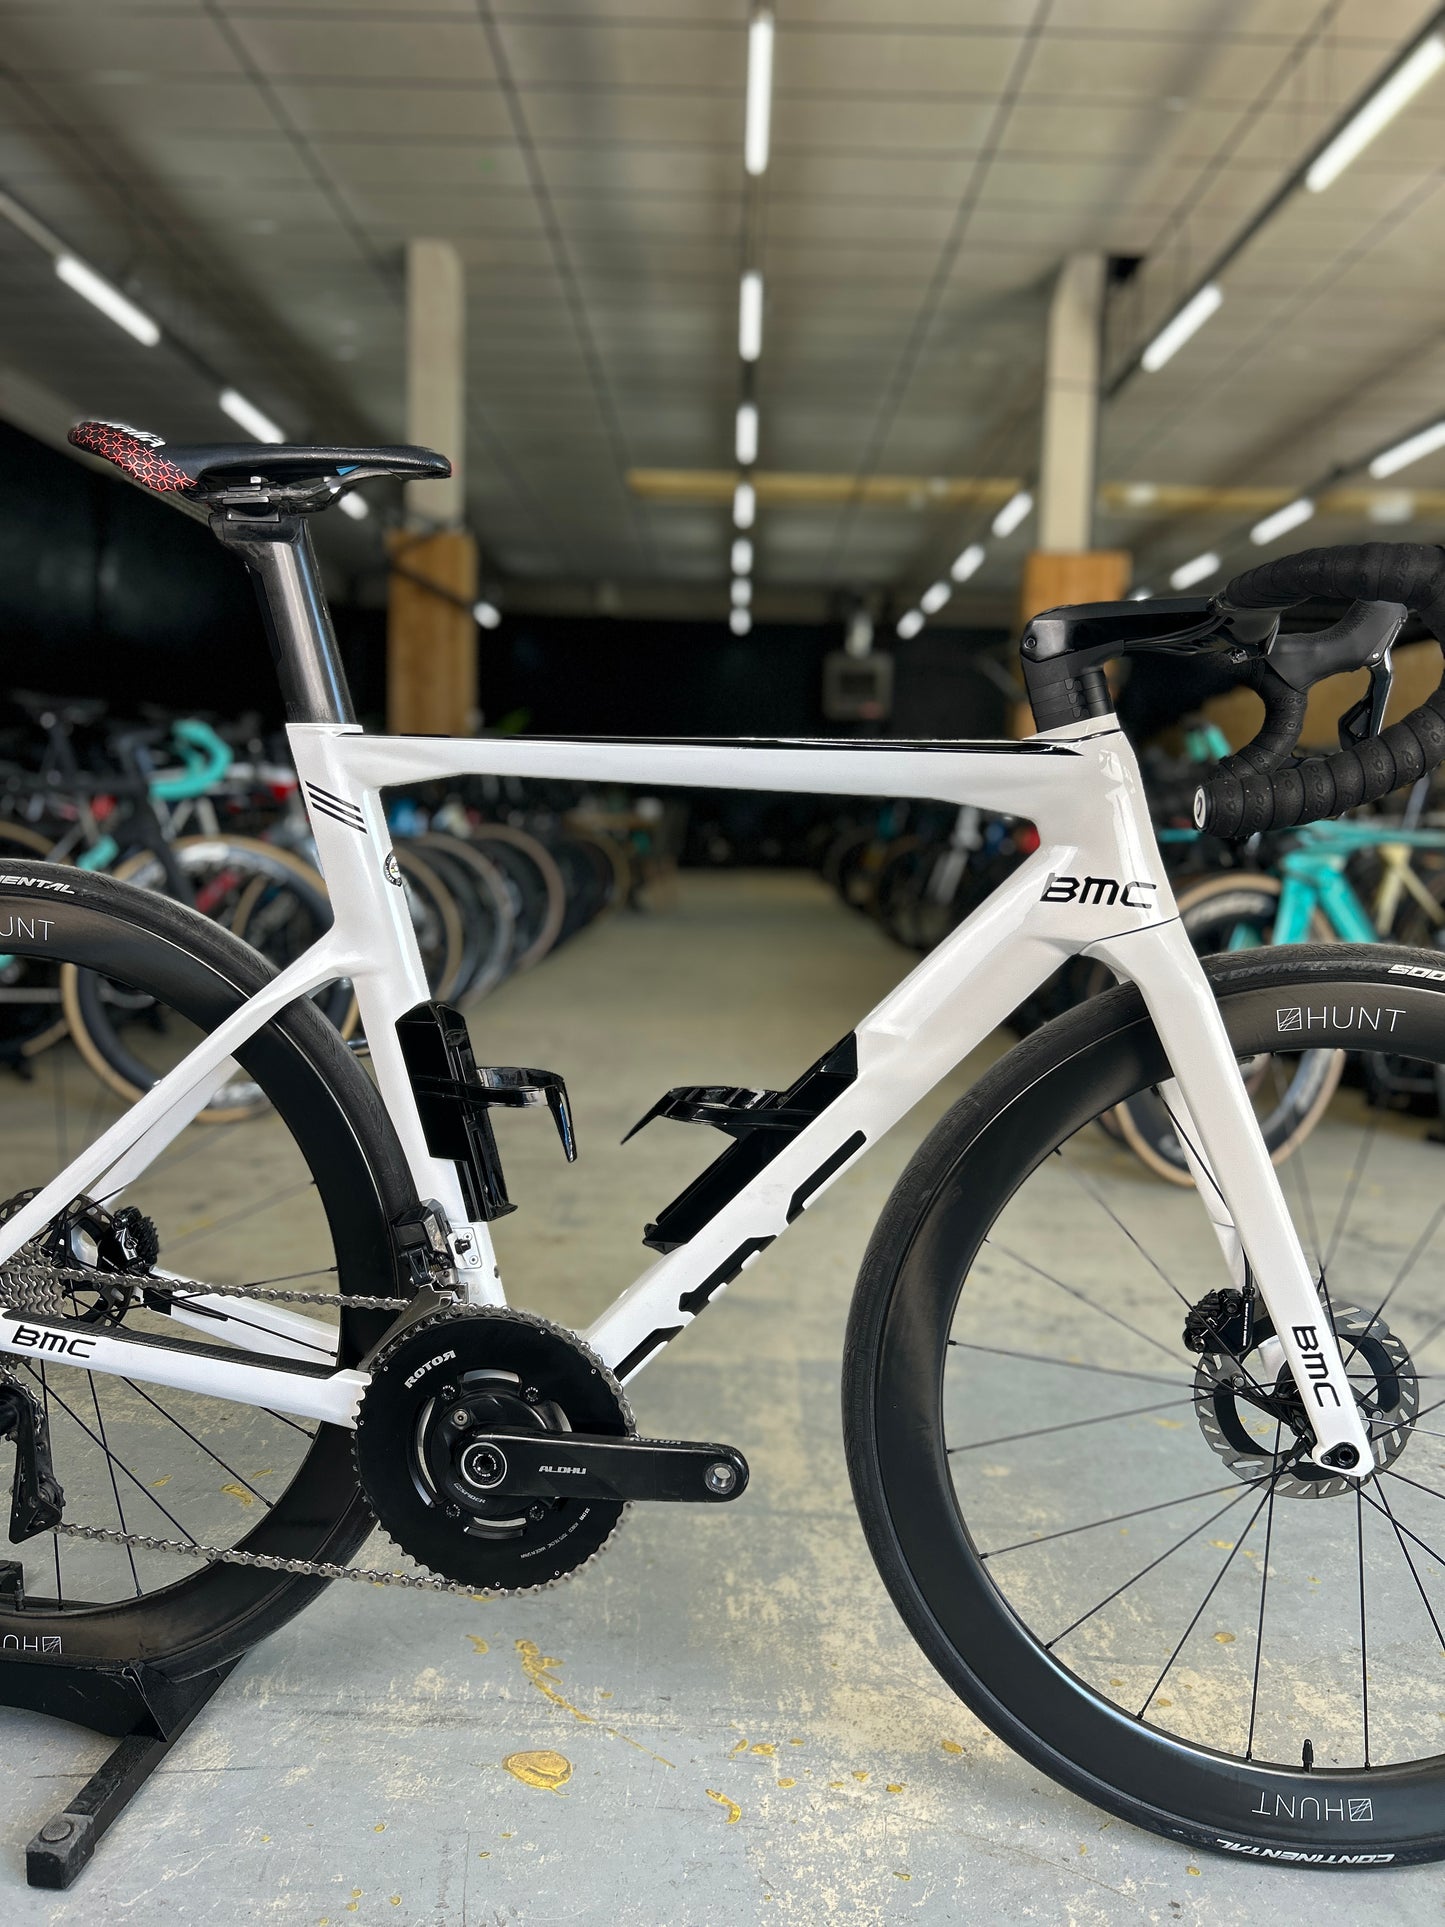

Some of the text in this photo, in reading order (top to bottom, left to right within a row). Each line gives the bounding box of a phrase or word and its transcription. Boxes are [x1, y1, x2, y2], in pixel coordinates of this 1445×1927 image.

[1040, 873, 1157, 909] BMC
[1307, 1006, 1406, 1032] HUNT
[11, 1325, 96, 1358] BMC
[404, 1350, 456, 1389] ROTOR
[1291, 1326, 1341, 1407] BMC
[538, 1465, 587, 1475] ALDHU
[1251, 1791, 1344, 1821] HUNT
[1216, 1838, 1395, 1864] CONTINENTAL
